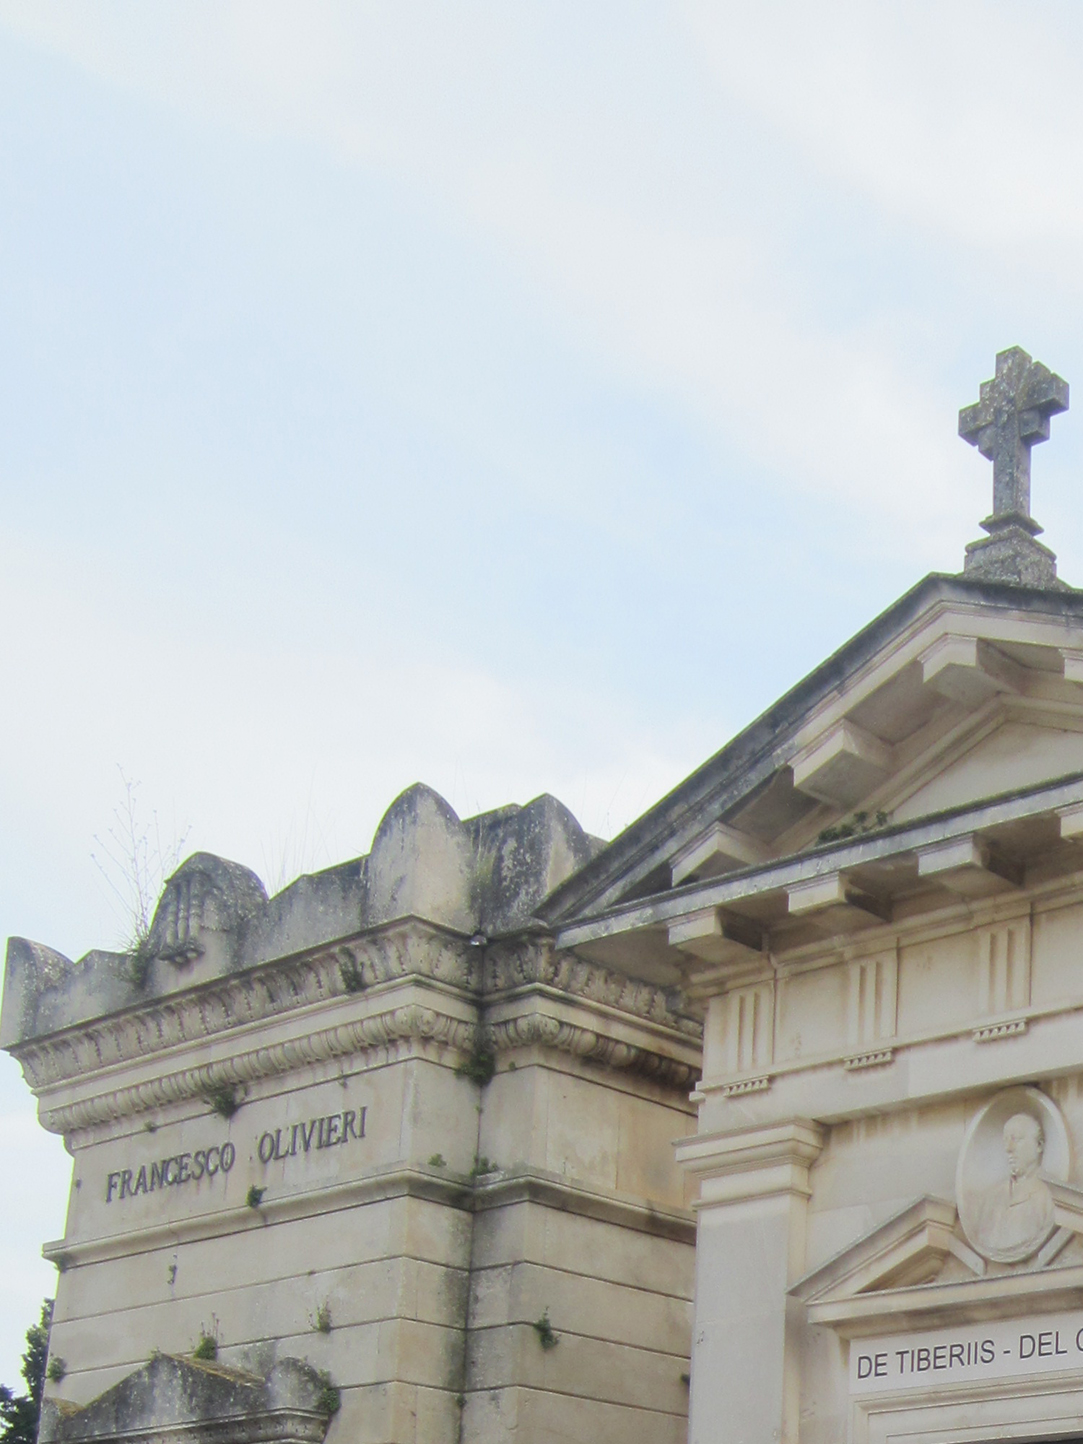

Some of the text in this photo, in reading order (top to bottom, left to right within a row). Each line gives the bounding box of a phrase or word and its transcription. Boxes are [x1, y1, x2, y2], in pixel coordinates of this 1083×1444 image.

[106, 1106, 368, 1203] FRANCESCO OLIVIERI
[857, 1353, 888, 1379] DE
[896, 1339, 996, 1374] TIBERIIS
[1019, 1331, 1068, 1360] DEL
